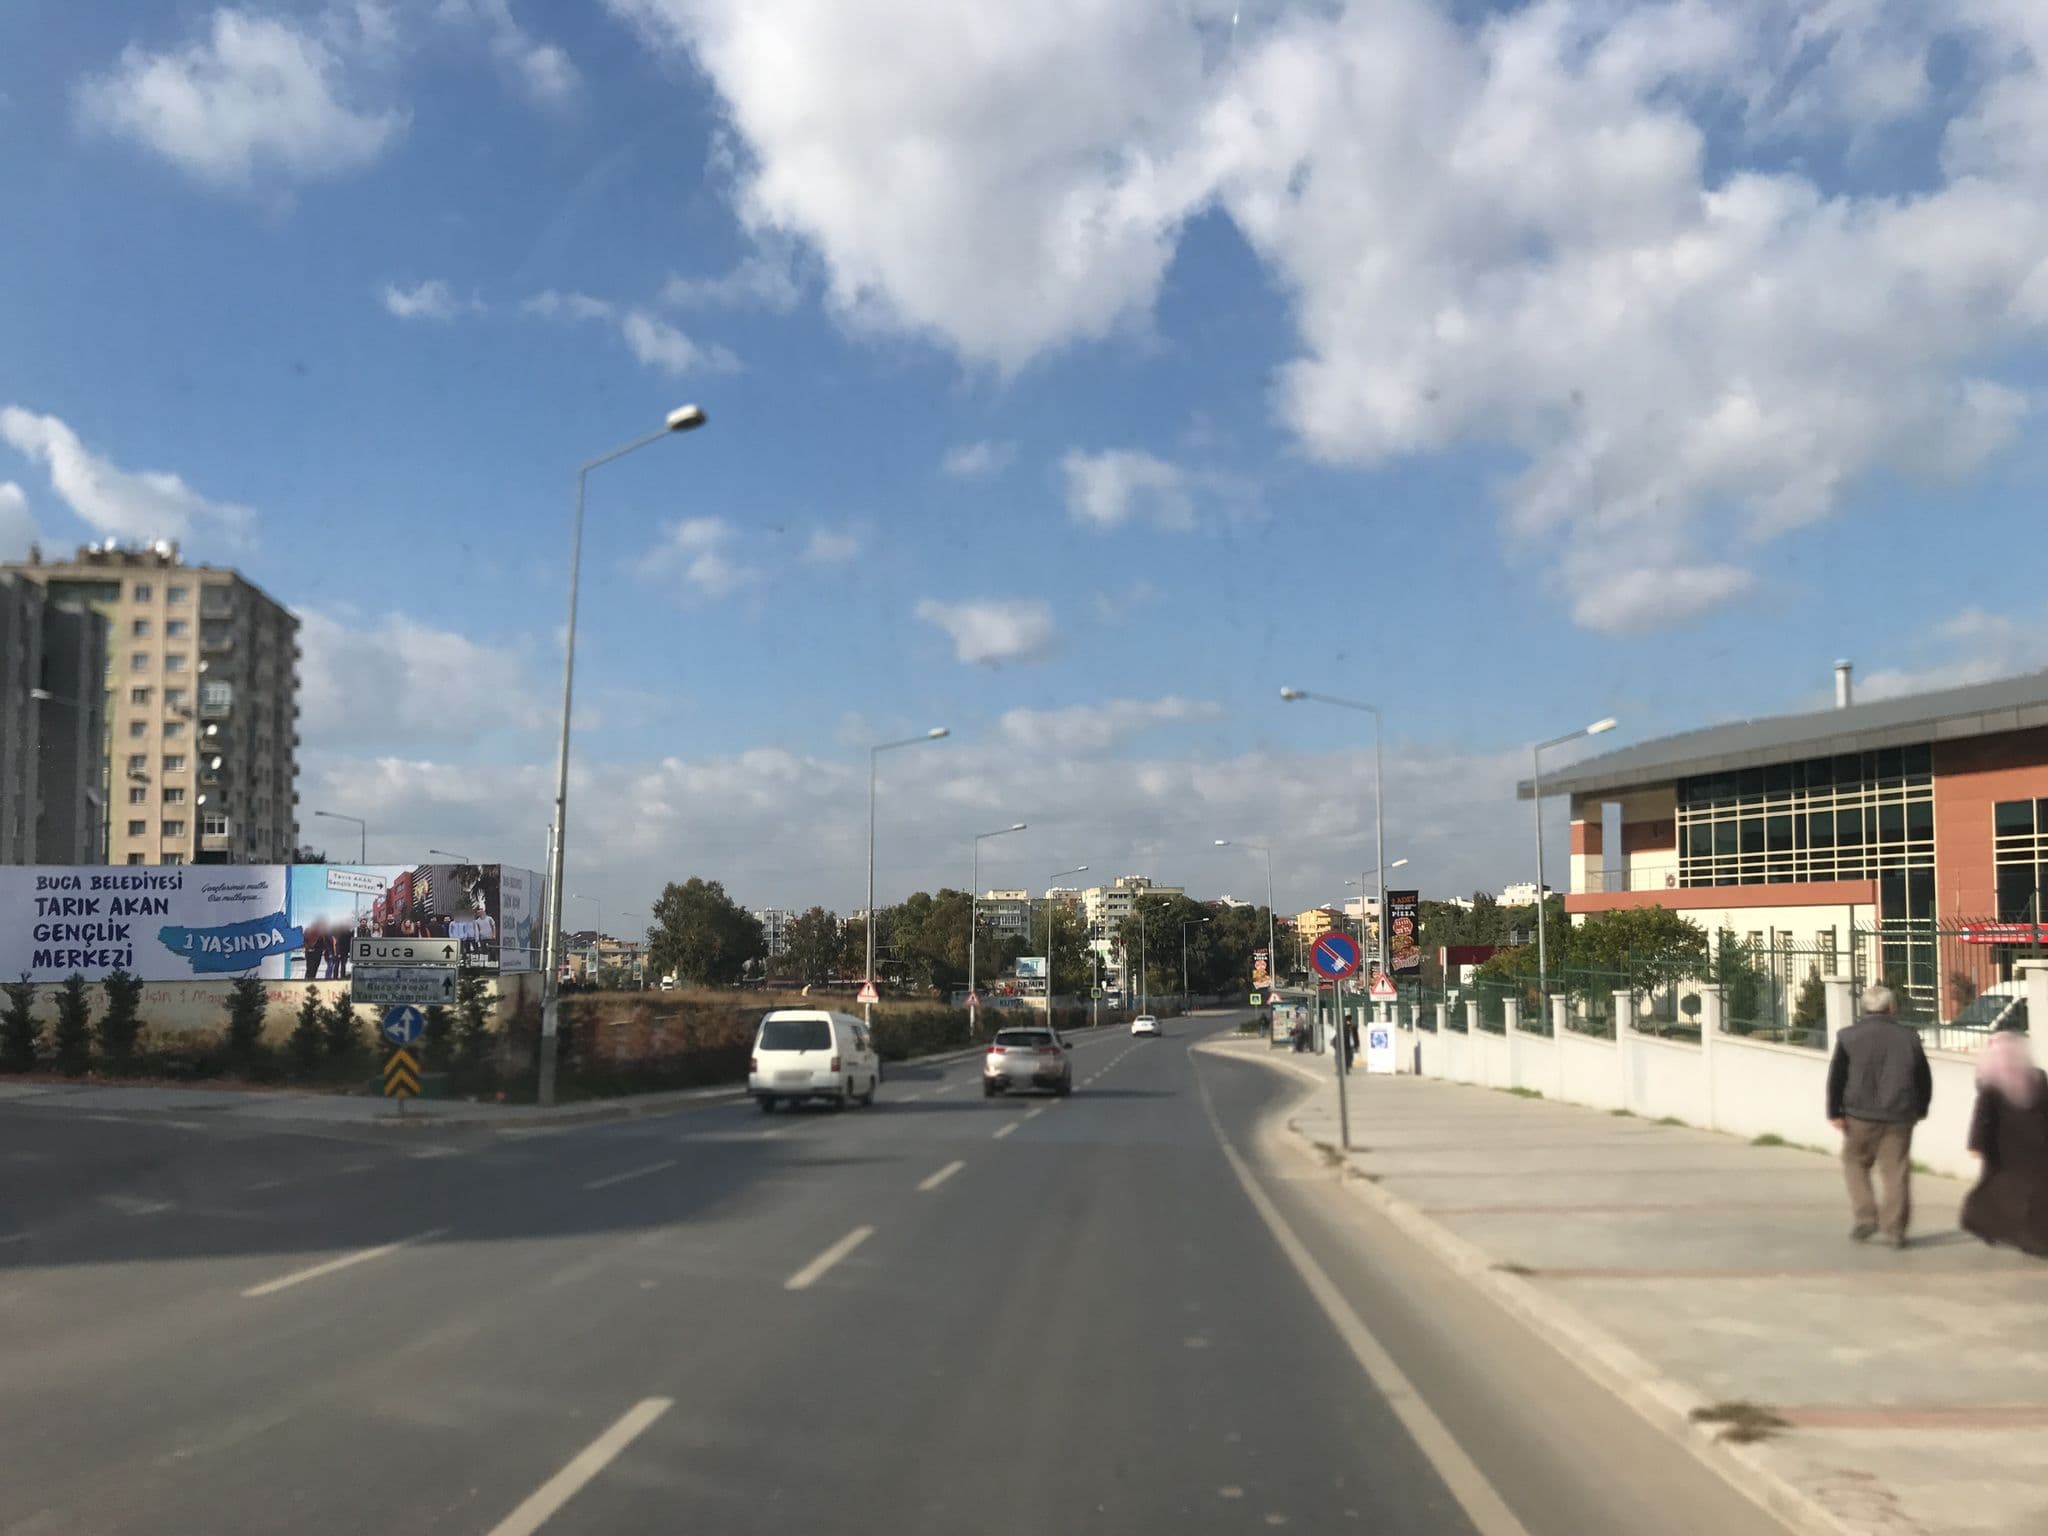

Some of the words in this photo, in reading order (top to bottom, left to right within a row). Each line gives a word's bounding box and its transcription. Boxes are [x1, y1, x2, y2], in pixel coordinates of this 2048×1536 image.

[36, 875, 82, 890] BUCA
[90, 870, 183, 890] BELEDİYESİ
[34, 896, 101, 917] TARIK
[109, 896, 169, 916] AKAN
[33, 917, 130, 948] GENÇLİK
[183, 933, 194, 950] 1
[199, 927, 285, 959] YAŞINDA
[32, 942, 133, 969] MERKEZİ
[359, 943, 414, 958] Buca
